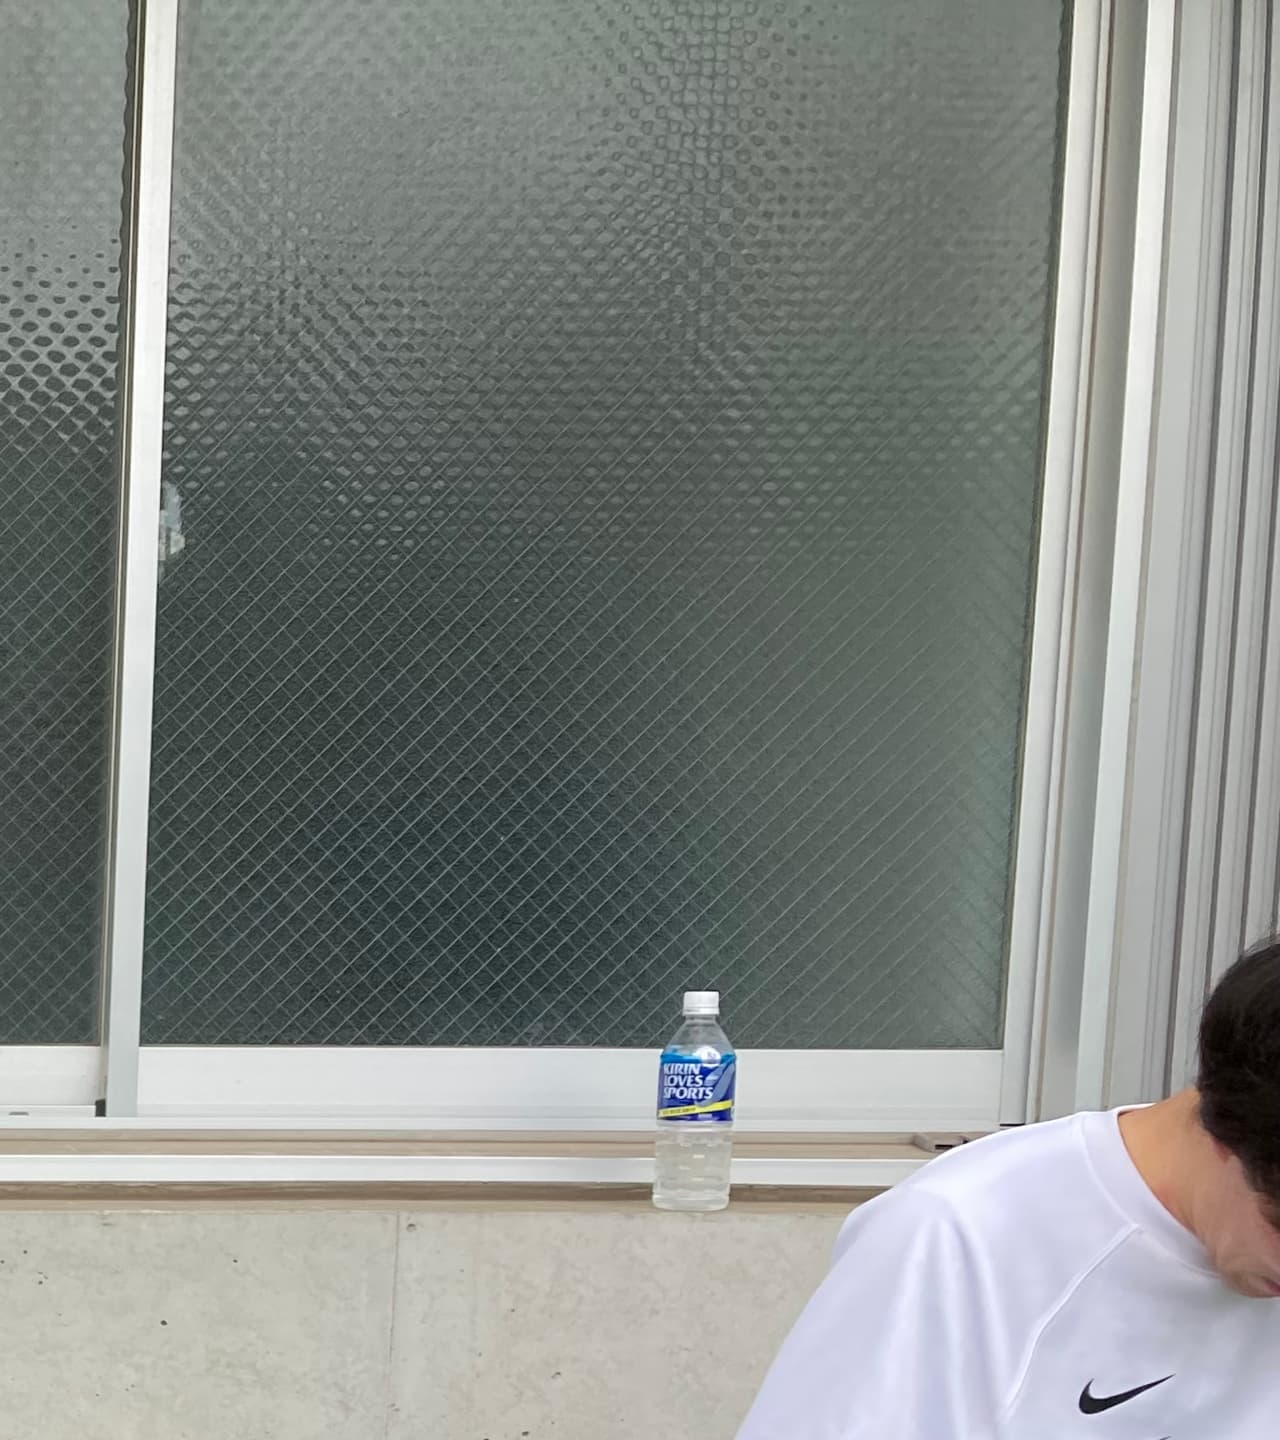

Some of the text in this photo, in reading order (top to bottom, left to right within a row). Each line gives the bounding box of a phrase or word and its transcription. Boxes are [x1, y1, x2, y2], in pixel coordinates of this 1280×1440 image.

[663, 1063, 701, 1075] KIRIN
[663, 1075, 704, 1087] LOVES
[663, 1087, 714, 1099] SPORTS
